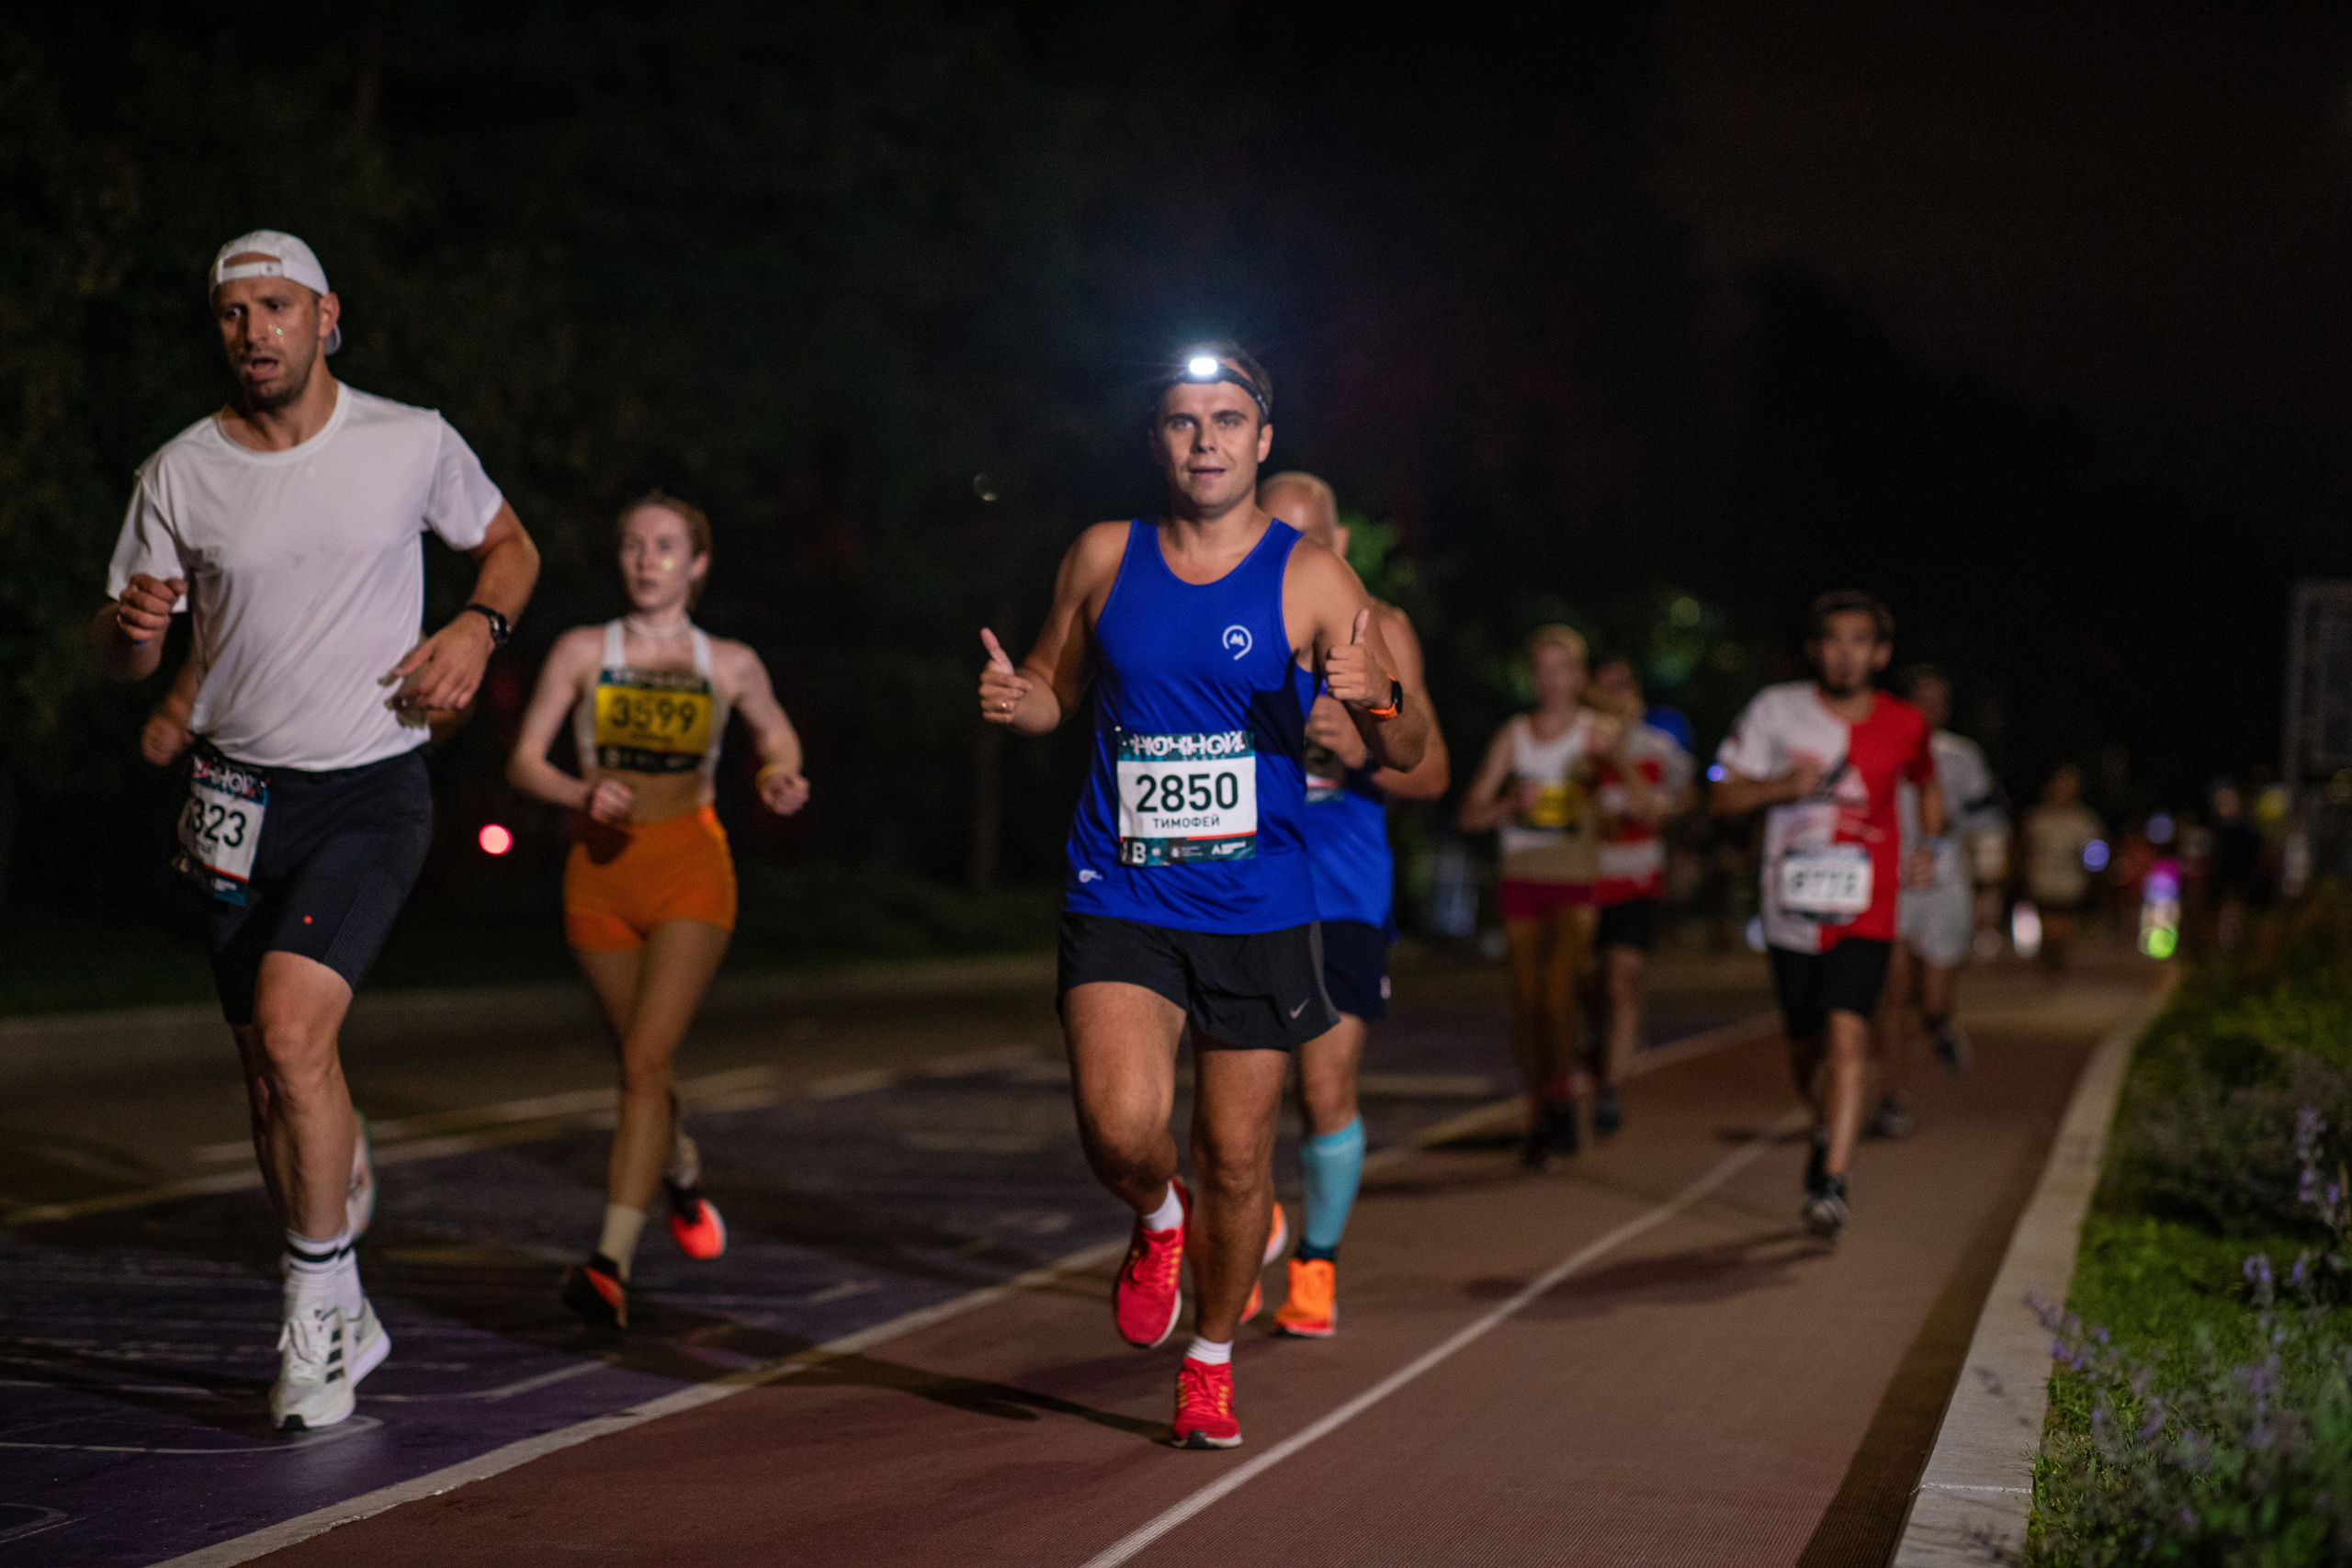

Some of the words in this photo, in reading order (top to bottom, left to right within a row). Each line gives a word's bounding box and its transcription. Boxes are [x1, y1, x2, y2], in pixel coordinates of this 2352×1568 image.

[609, 694, 698, 733] 3599
[1136, 772, 1238, 813] 2850
[1153, 814, 1220, 829] ТИМОФЕЙ
